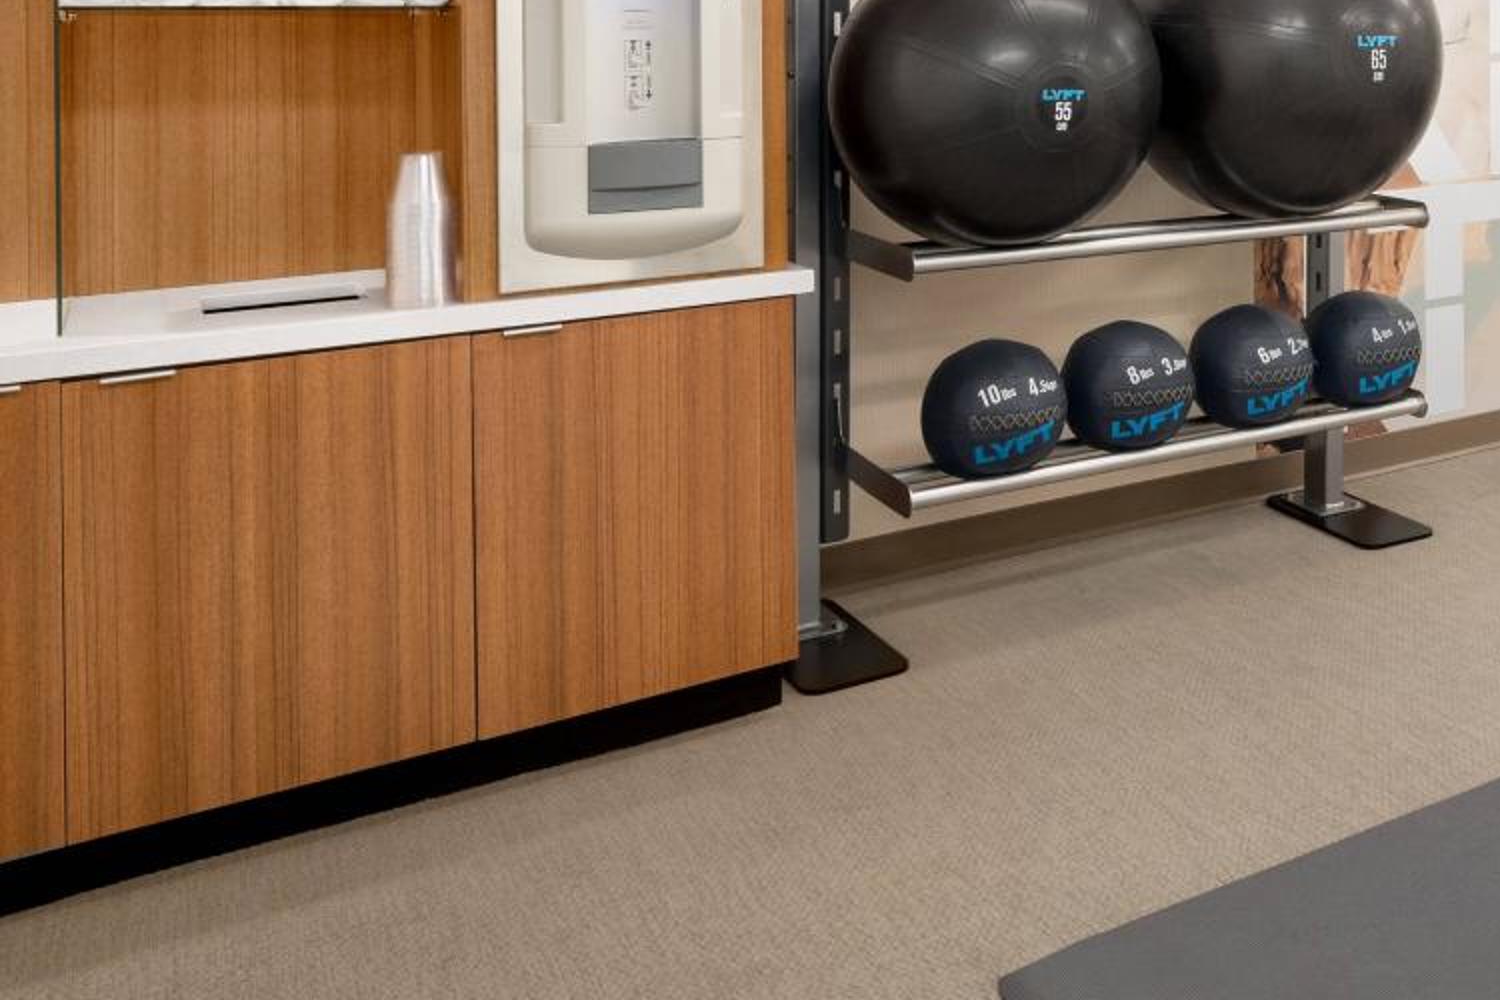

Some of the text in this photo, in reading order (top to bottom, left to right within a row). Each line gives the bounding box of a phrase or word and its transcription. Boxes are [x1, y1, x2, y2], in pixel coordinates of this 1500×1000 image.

[1357, 35, 1396, 47] LYFT
[1371, 49, 1387, 69] 65
[1055, 101, 1072, 120] 55
[1359, 359, 1416, 393] LYFT
[1246, 376, 1309, 416] LYFT
[1111, 400, 1185, 438] LYFT
[974, 417, 1055, 465] LYFT
